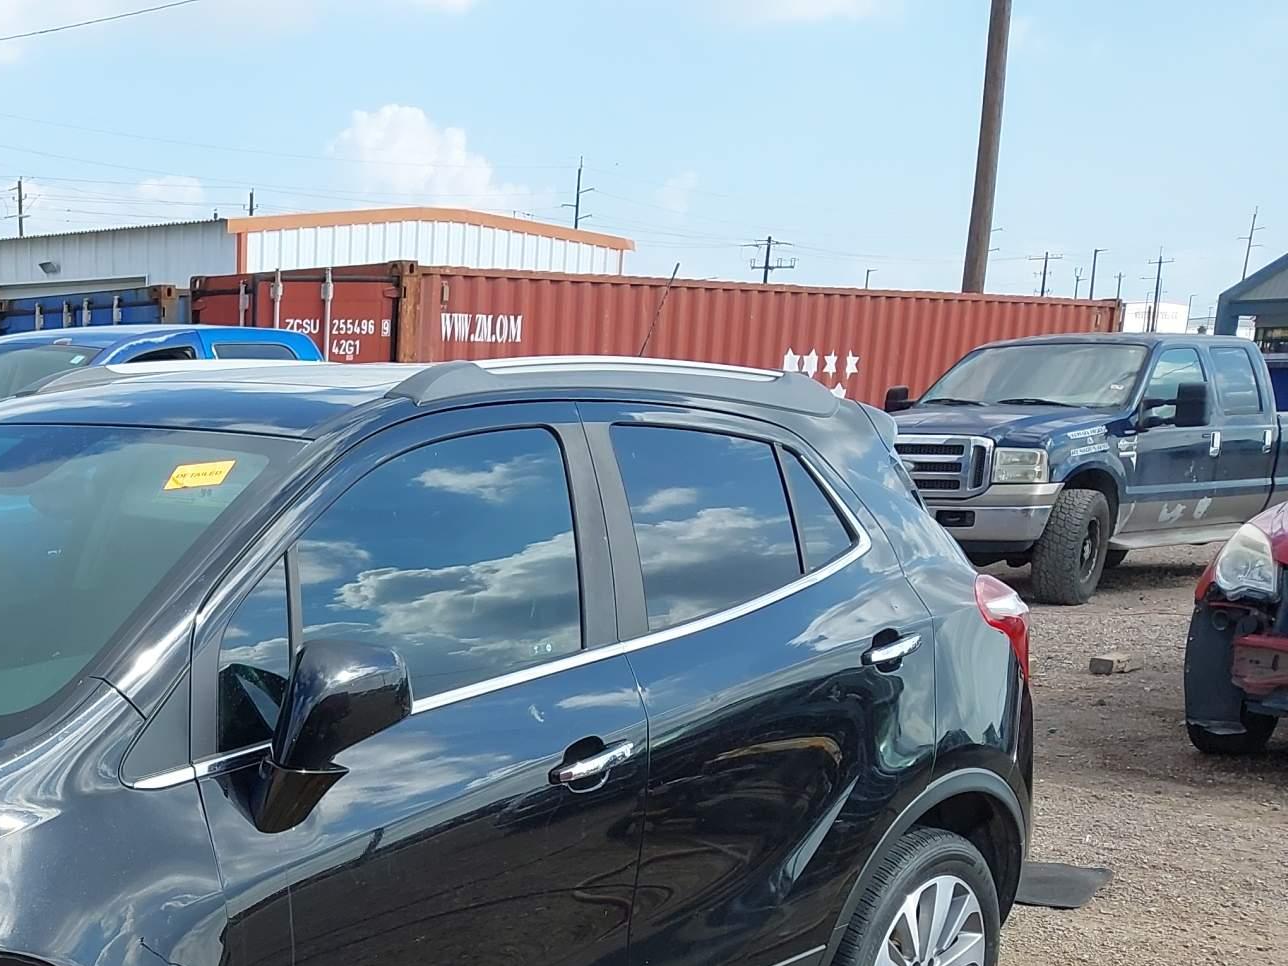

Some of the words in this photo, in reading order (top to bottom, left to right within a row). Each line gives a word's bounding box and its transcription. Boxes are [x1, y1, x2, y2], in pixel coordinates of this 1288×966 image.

[284, 319, 320, 334] ZCSU
[331, 319, 375, 335] 255496
[331, 339, 360, 355] 42G1
